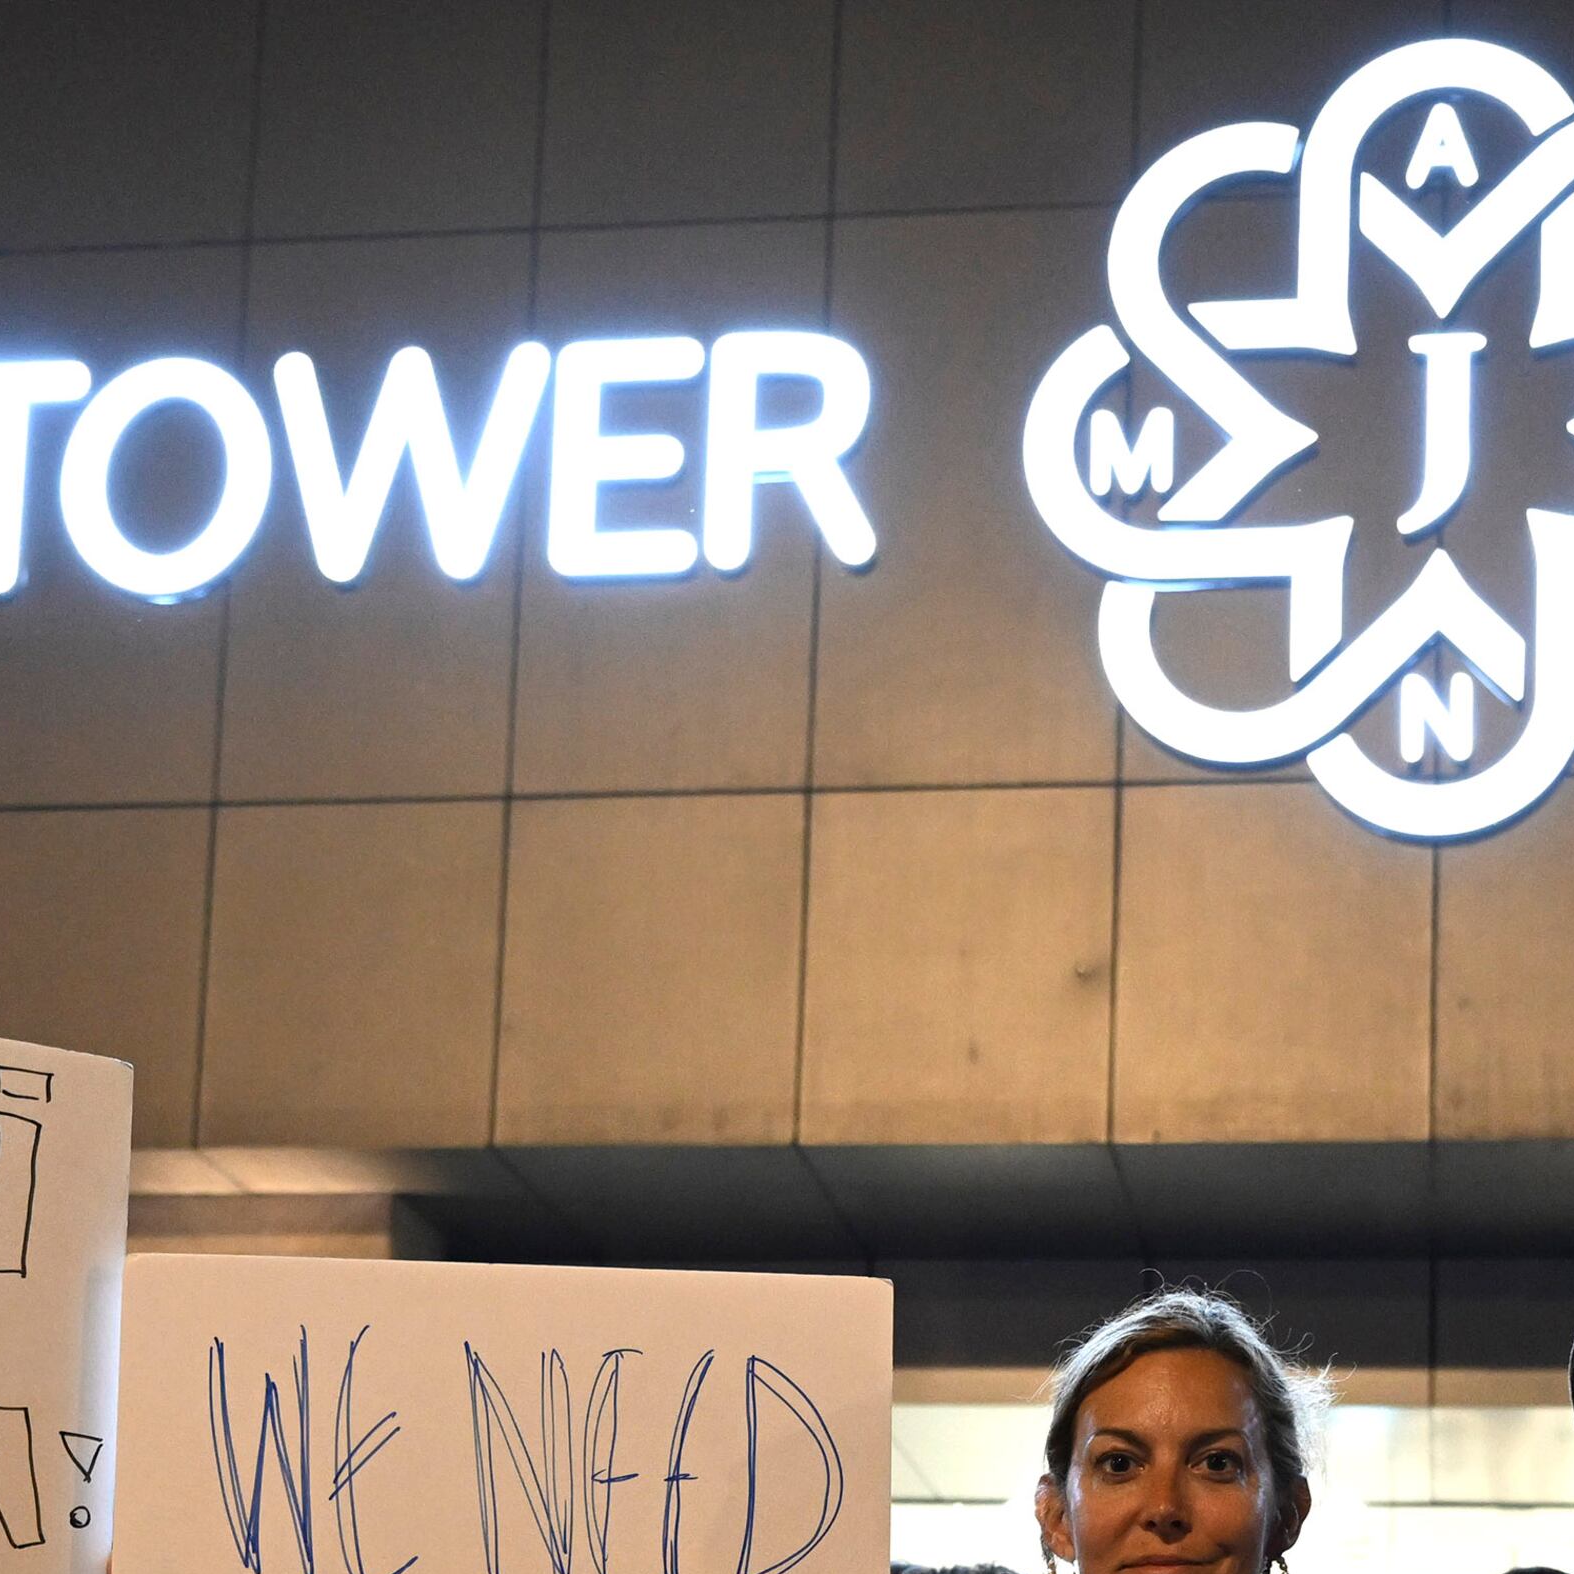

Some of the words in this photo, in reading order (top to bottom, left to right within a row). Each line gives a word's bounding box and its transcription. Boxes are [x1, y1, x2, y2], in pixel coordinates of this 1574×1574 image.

[1405, 102, 1478, 189] A
[1089, 406, 1175, 497] M
[1396, 331, 1488, 536] J
[1399, 672, 1475, 764] N
